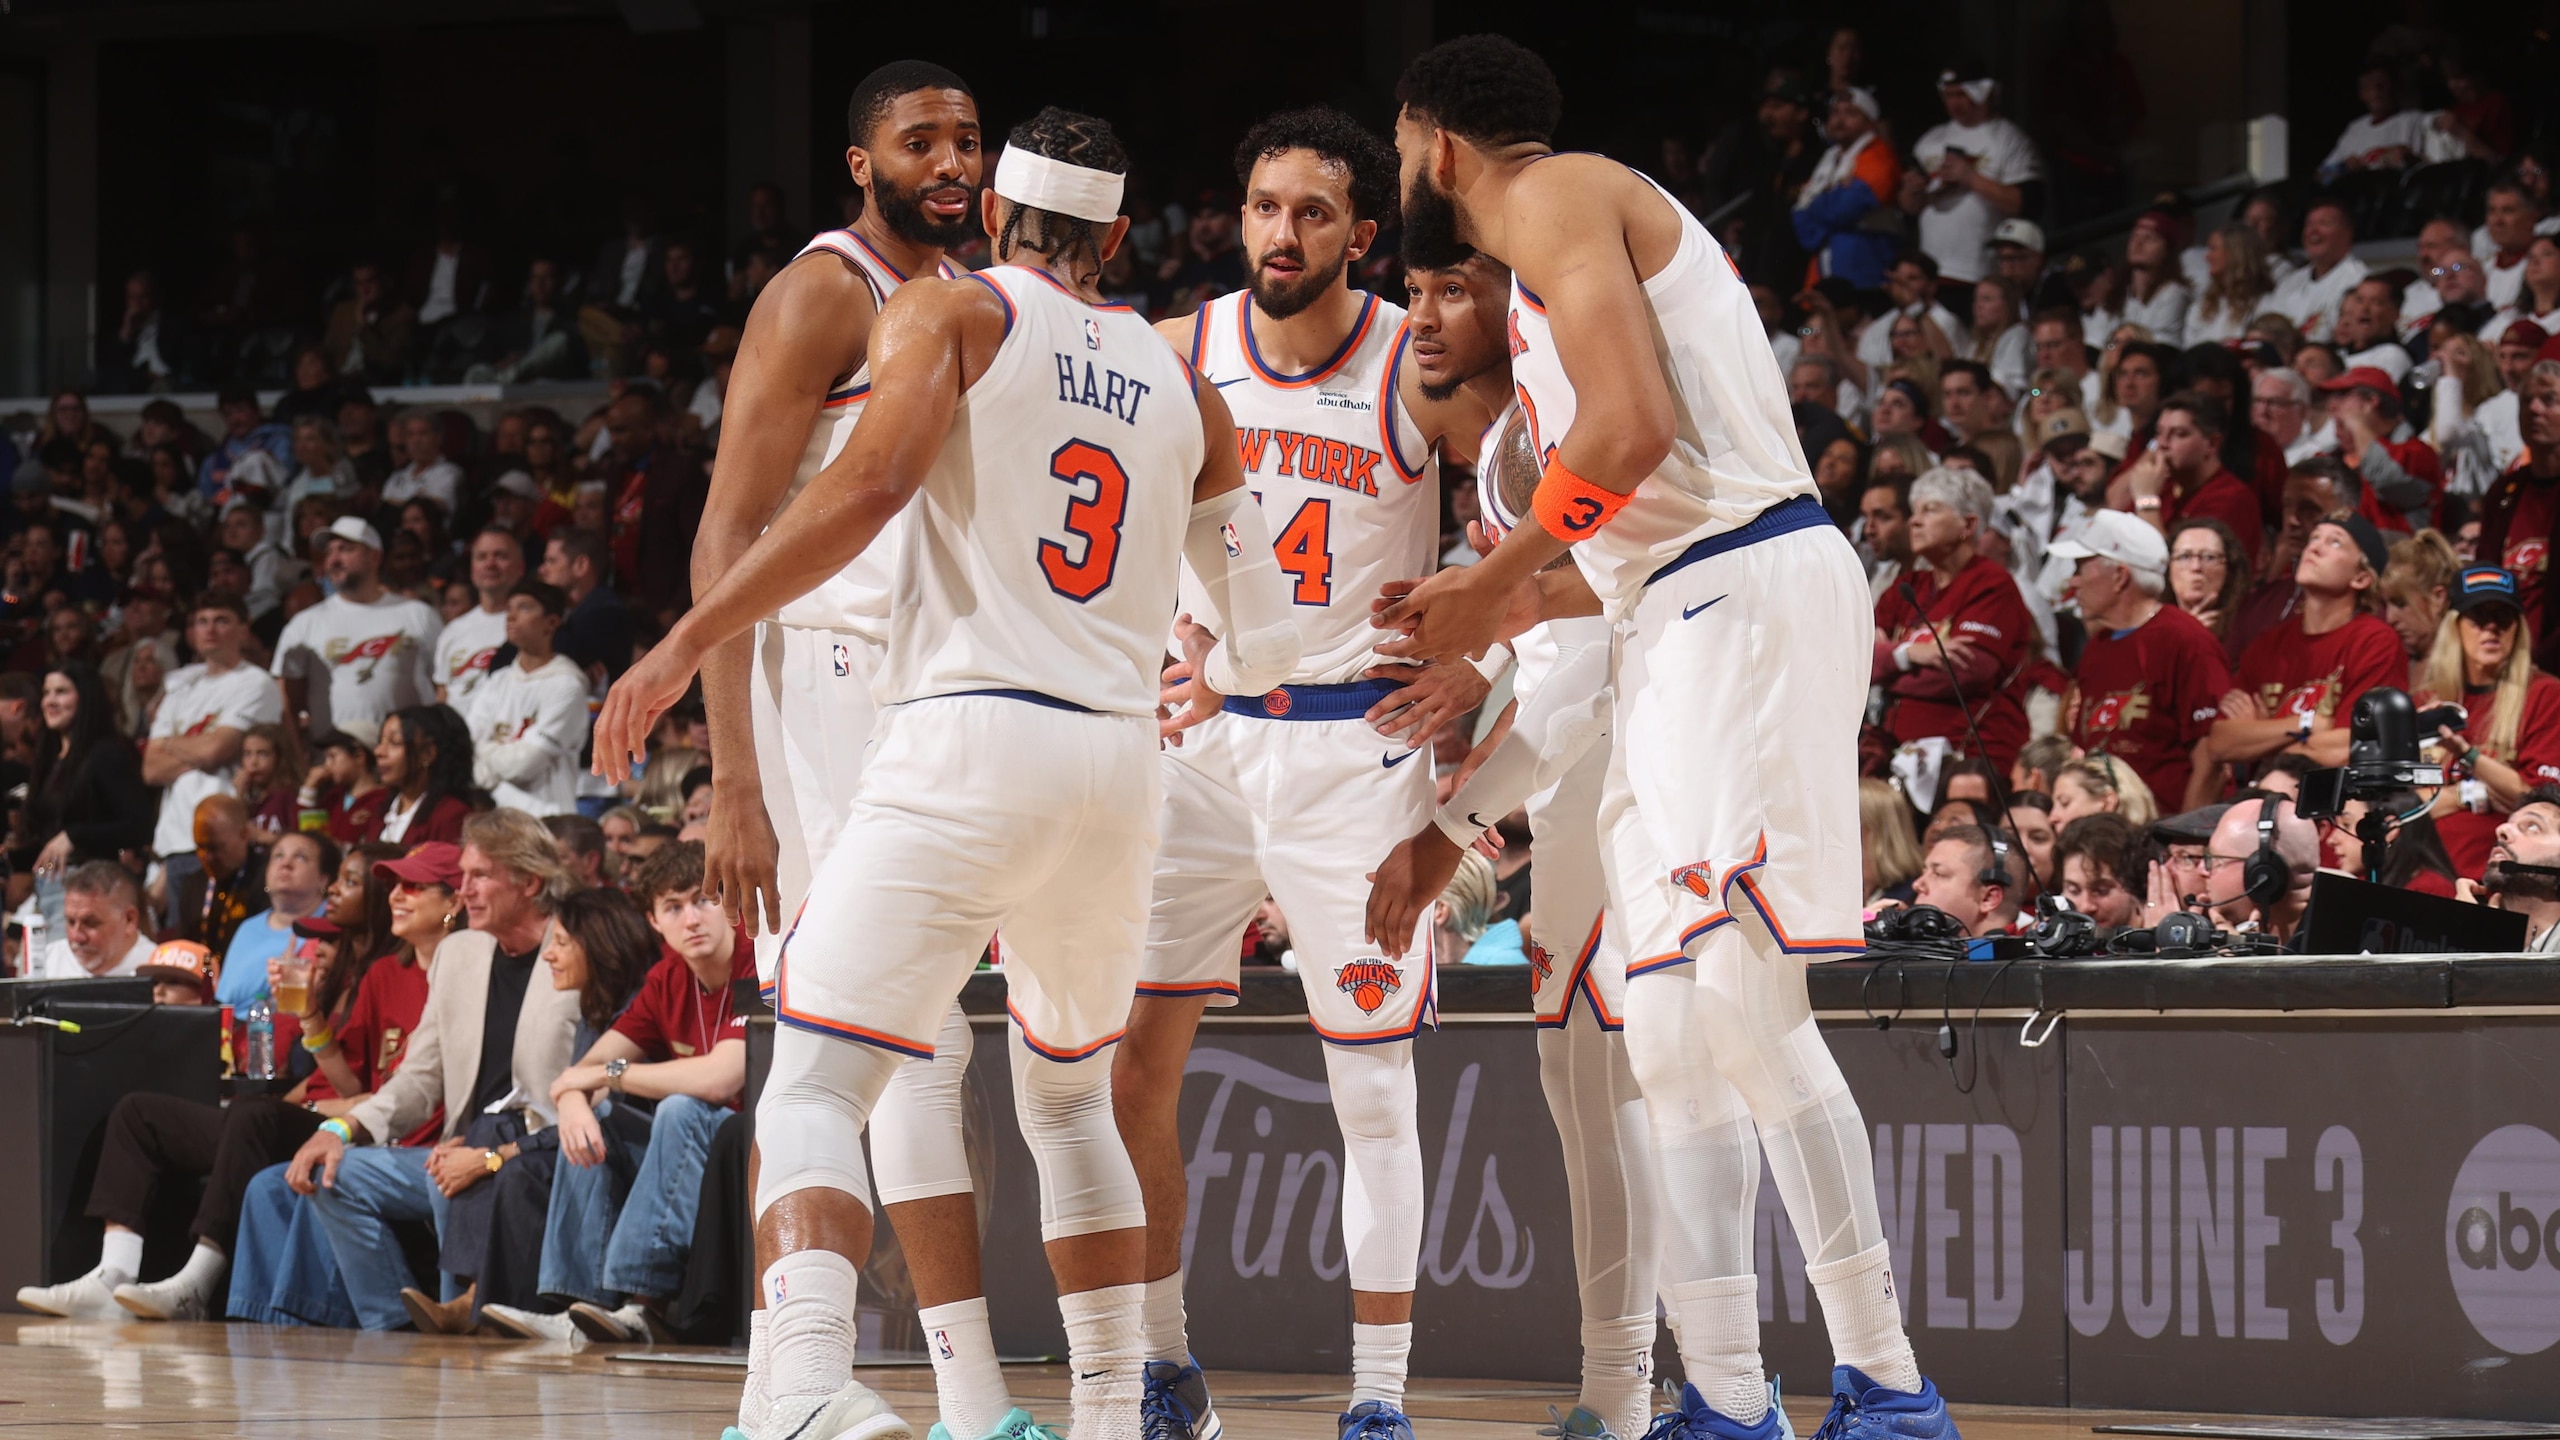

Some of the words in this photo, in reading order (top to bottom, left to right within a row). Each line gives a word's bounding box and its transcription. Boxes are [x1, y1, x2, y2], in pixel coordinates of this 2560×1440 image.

[1054, 352, 1151, 426] HART
[1317, 397, 1338, 407] abu
[1339, 398, 1372, 411] dhabi
[1274, 430, 1383, 499] YORK
[1037, 436, 1130, 605] 3
[1250, 490, 1334, 608] 4
[1337, 962, 1402, 988] KNICKS
[1183, 1047, 1535, 1289] Finls
[2064, 1125, 2290, 1341] JUNE
[2314, 1124, 2365, 1346] 3
